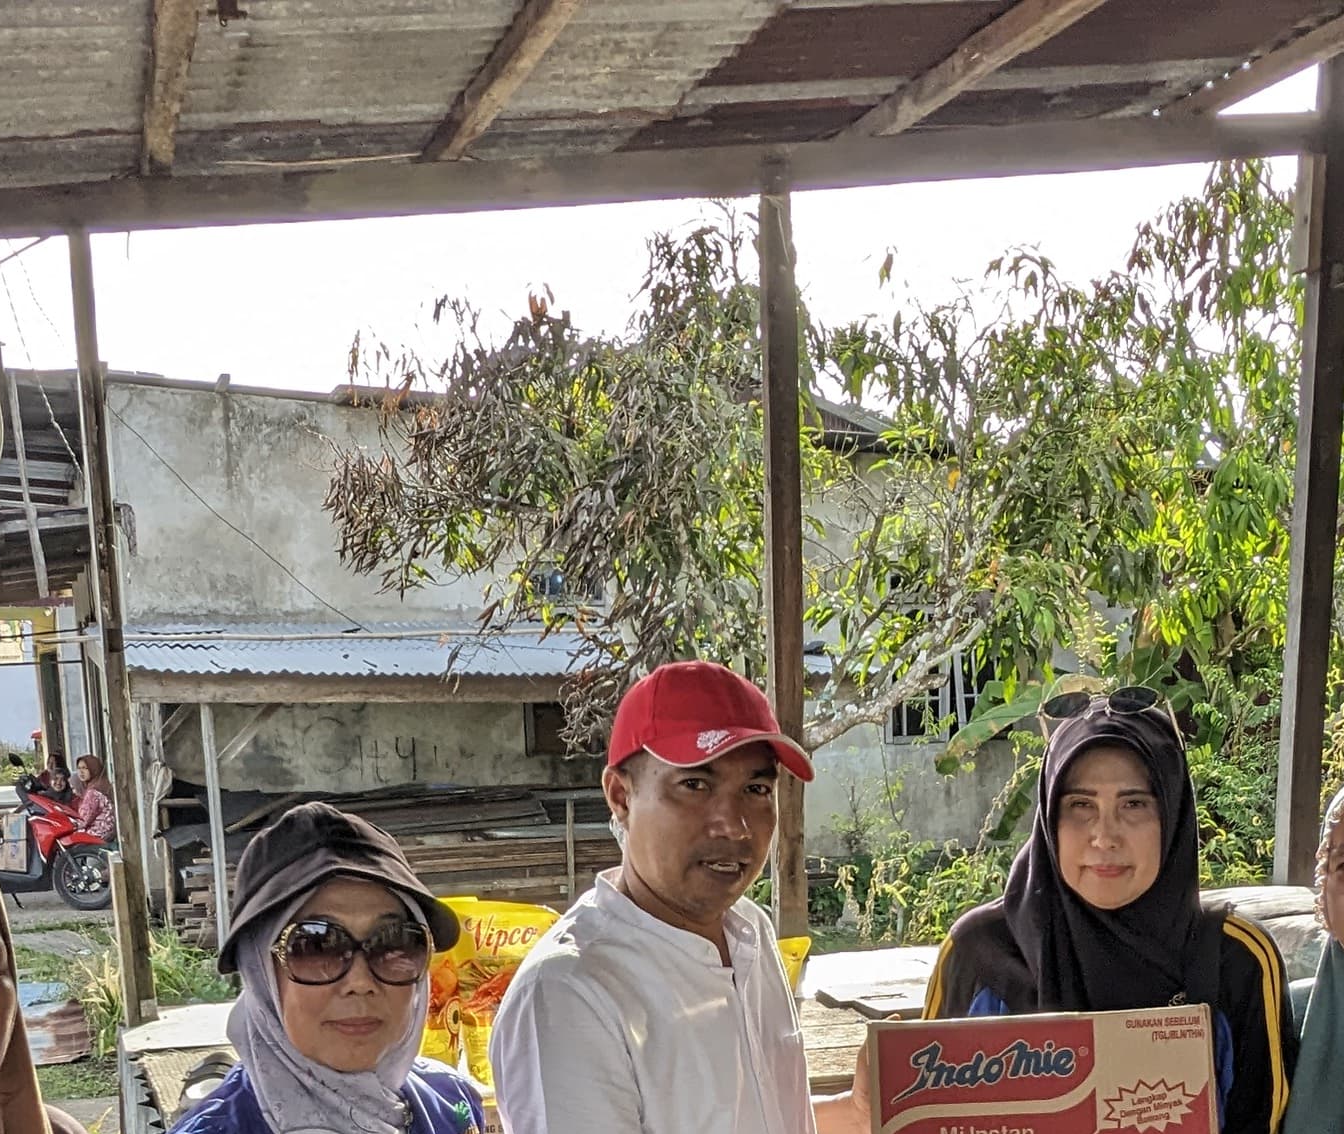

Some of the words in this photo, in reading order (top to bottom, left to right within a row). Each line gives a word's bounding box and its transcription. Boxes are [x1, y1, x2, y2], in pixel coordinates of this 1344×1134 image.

[464, 914, 538, 956] Vipco
[1126, 1018, 1163, 1029] GUNAKAN
[1164, 1016, 1201, 1027] SEBELUM
[1132, 1092, 1167, 1106] Lengkap
[1120, 1106, 1152, 1118] Dengan
[1154, 1100, 1183, 1111] Minyak
